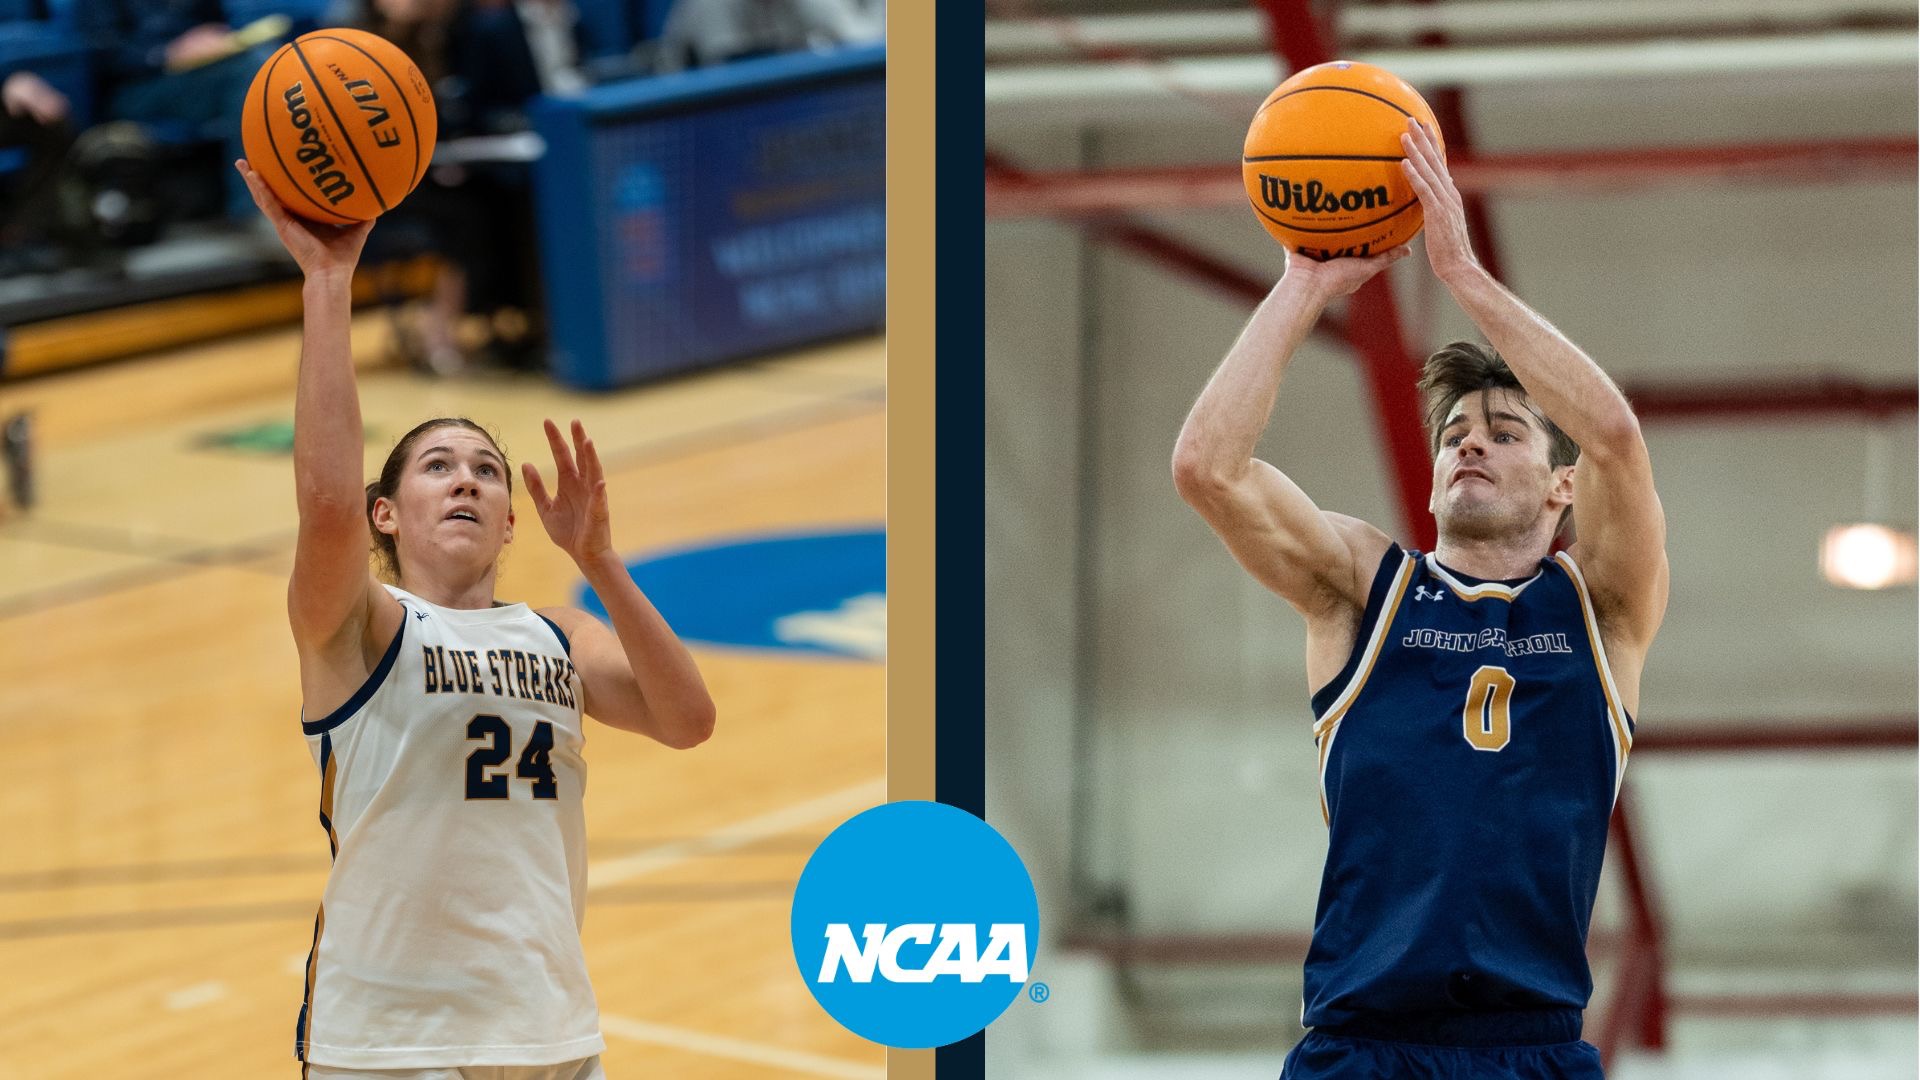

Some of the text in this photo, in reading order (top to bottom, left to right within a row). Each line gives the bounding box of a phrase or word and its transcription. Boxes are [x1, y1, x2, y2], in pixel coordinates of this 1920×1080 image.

[326, 63, 348, 81] NXT
[283, 80, 355, 206] Wilson
[1258, 173, 1389, 214] Wilson
[1402, 628, 1572, 657] JOHN CAROLL
[422, 645, 577, 711] BLUE STREAKS
[1462, 665, 1516, 752] 0
[464, 713, 559, 801] 24
